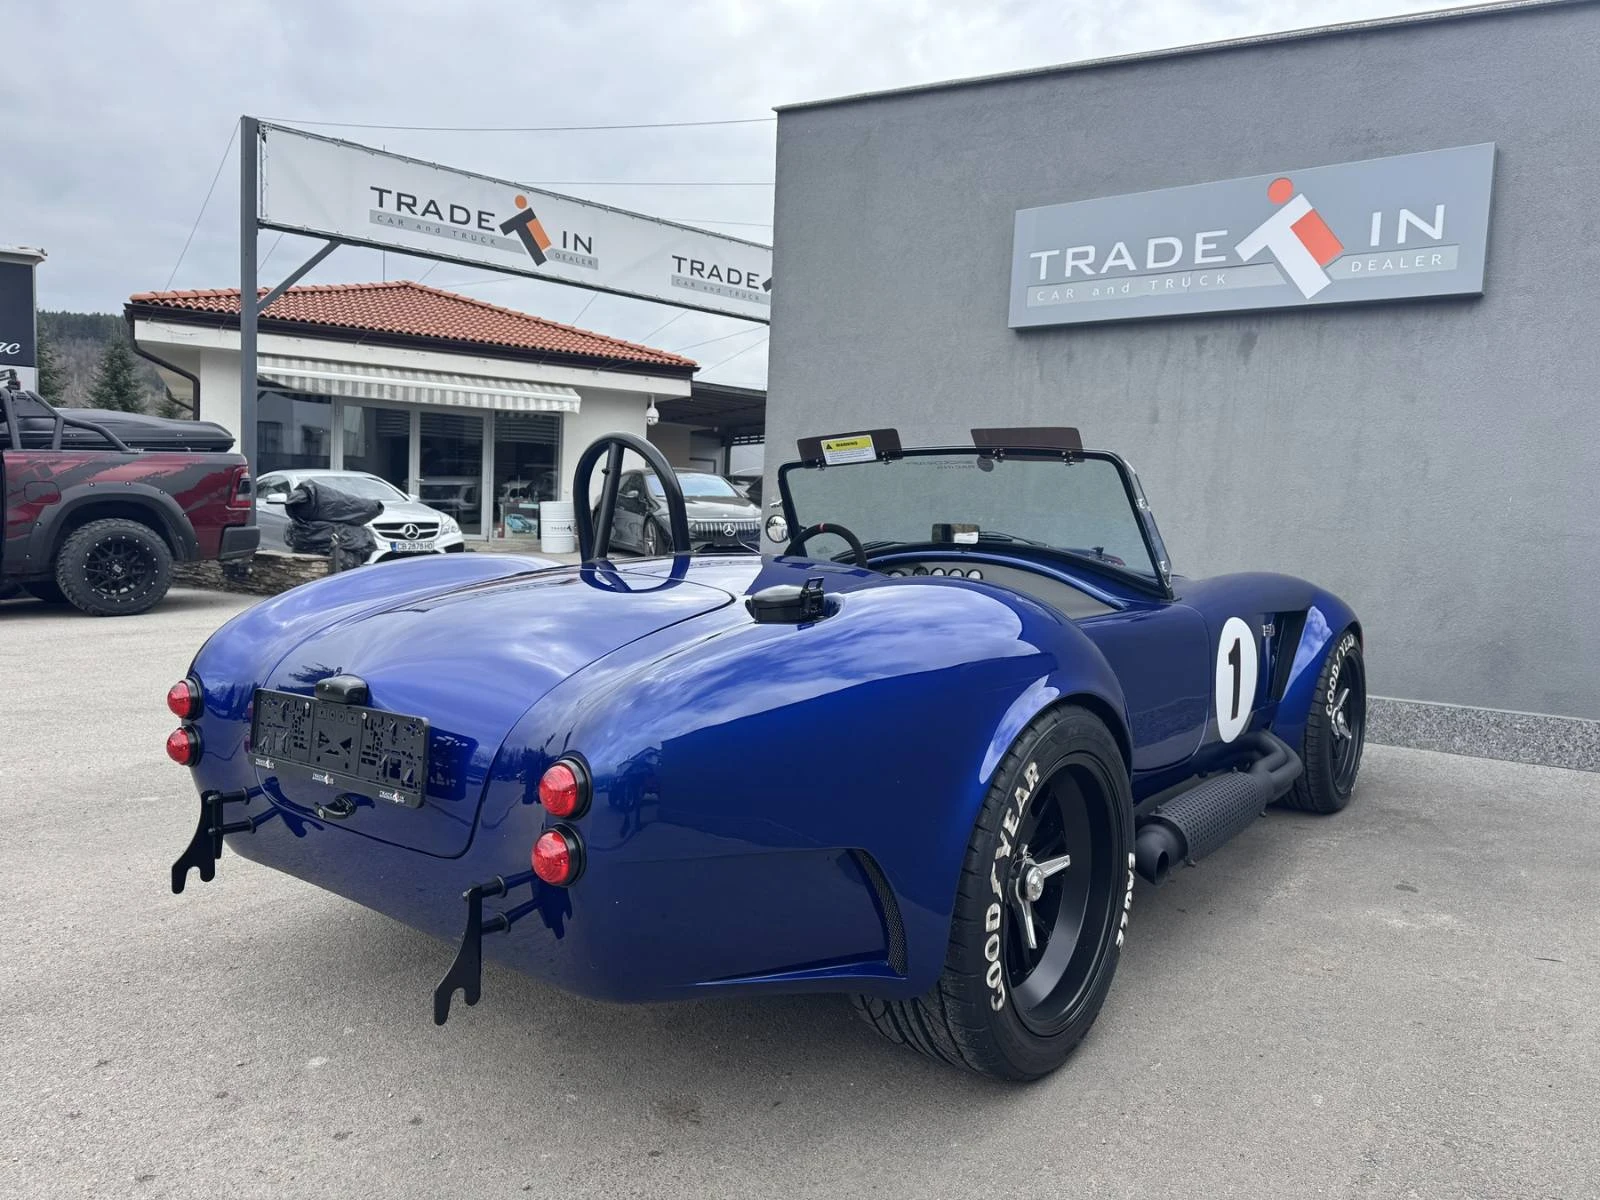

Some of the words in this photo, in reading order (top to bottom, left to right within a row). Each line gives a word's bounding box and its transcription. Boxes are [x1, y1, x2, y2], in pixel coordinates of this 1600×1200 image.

[370, 186, 496, 232] TRADE
[562, 230, 592, 254] IN
[377, 214, 404, 227] CAR
[416, 224, 441, 234] and
[452, 230, 496, 246] TRUCK
[555, 252, 593, 266] DEALER
[1029, 229, 1228, 280] TRADE
[1370, 204, 1445, 247] IN
[672, 255, 760, 290] TRADE
[676, 278, 696, 288] CAR
[729, 290, 760, 301] TRUCK
[1037, 288, 1074, 301] CAR
[1092, 283, 1129, 297] and
[1149, 273, 1227, 291] TRUCK
[1351, 254, 1442, 273] DEALER
[1228, 637, 1242, 721] 1
[984, 761, 1040, 1012] GOODYEAR
[1116, 852, 1137, 952] EAGLE
